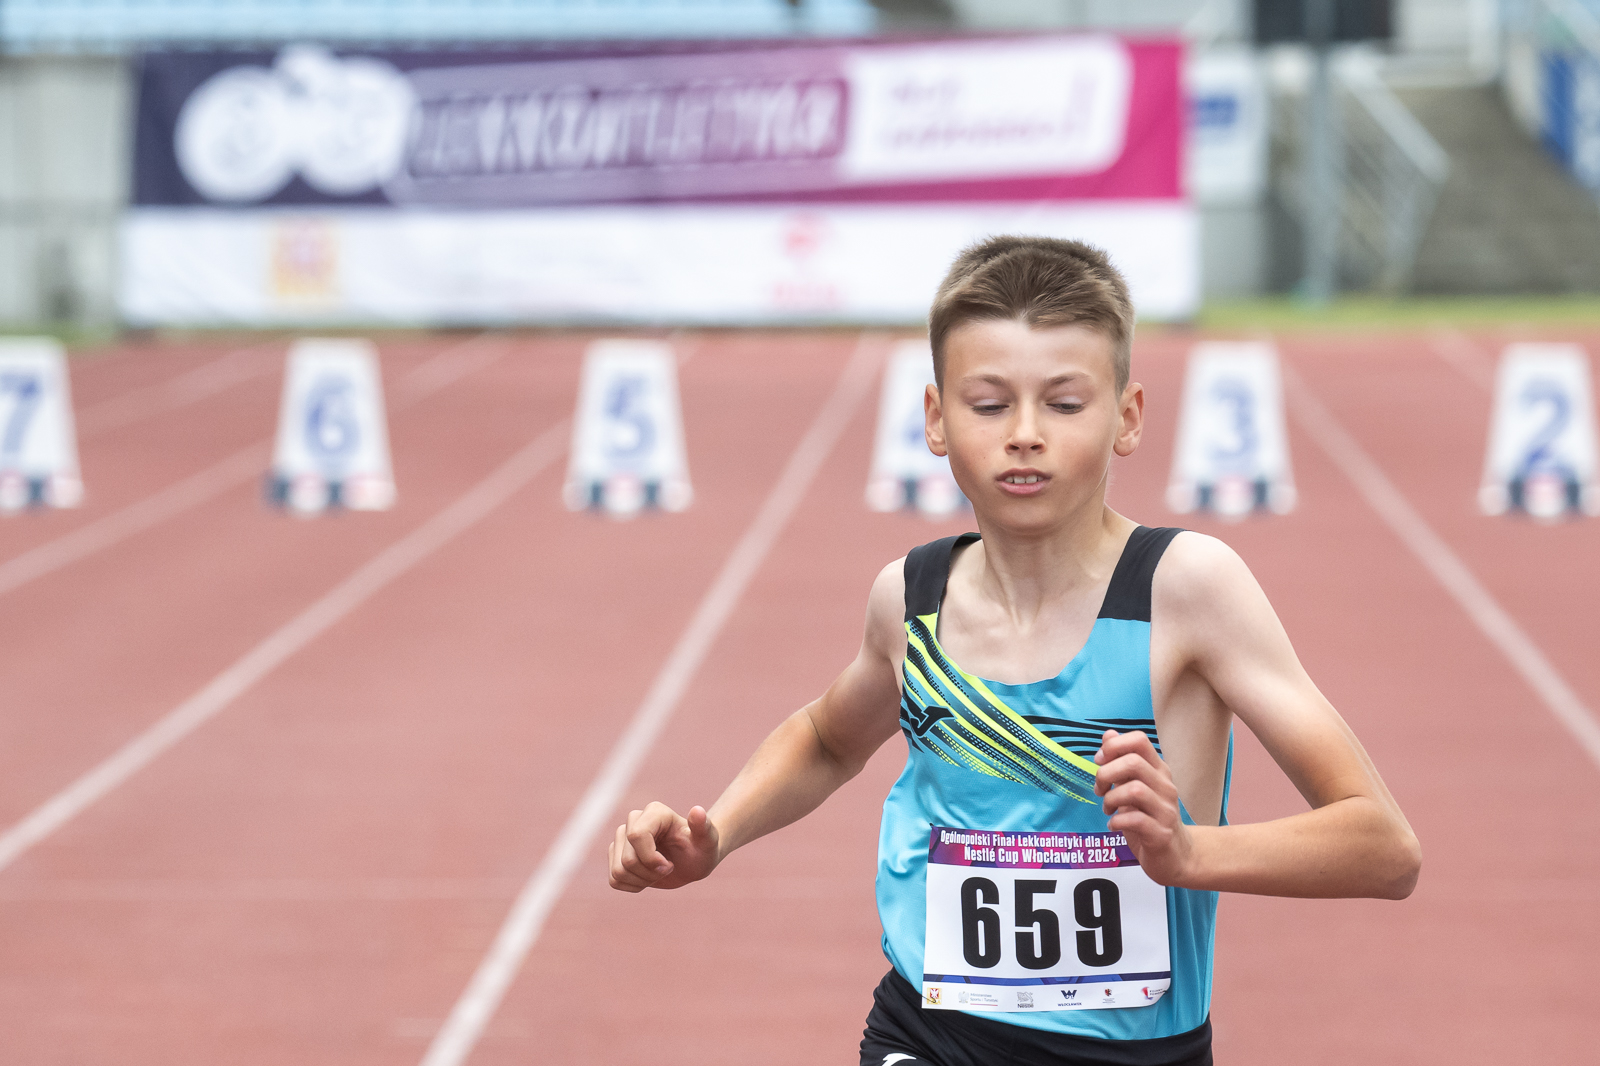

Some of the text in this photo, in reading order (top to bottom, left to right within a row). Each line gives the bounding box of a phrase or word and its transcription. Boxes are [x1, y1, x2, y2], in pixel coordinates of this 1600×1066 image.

[303, 374, 362, 462] 6
[600, 374, 658, 462] 5
[1204, 374, 1262, 466] 3
[1515, 376, 1578, 478] 2
[940, 829, 1128, 850] Ogólnopolski Finał Lekkoatletyki dla każd
[964, 846, 1118, 865] Nestlé Cup Włocławek 2024
[960, 876, 1123, 970] 659
